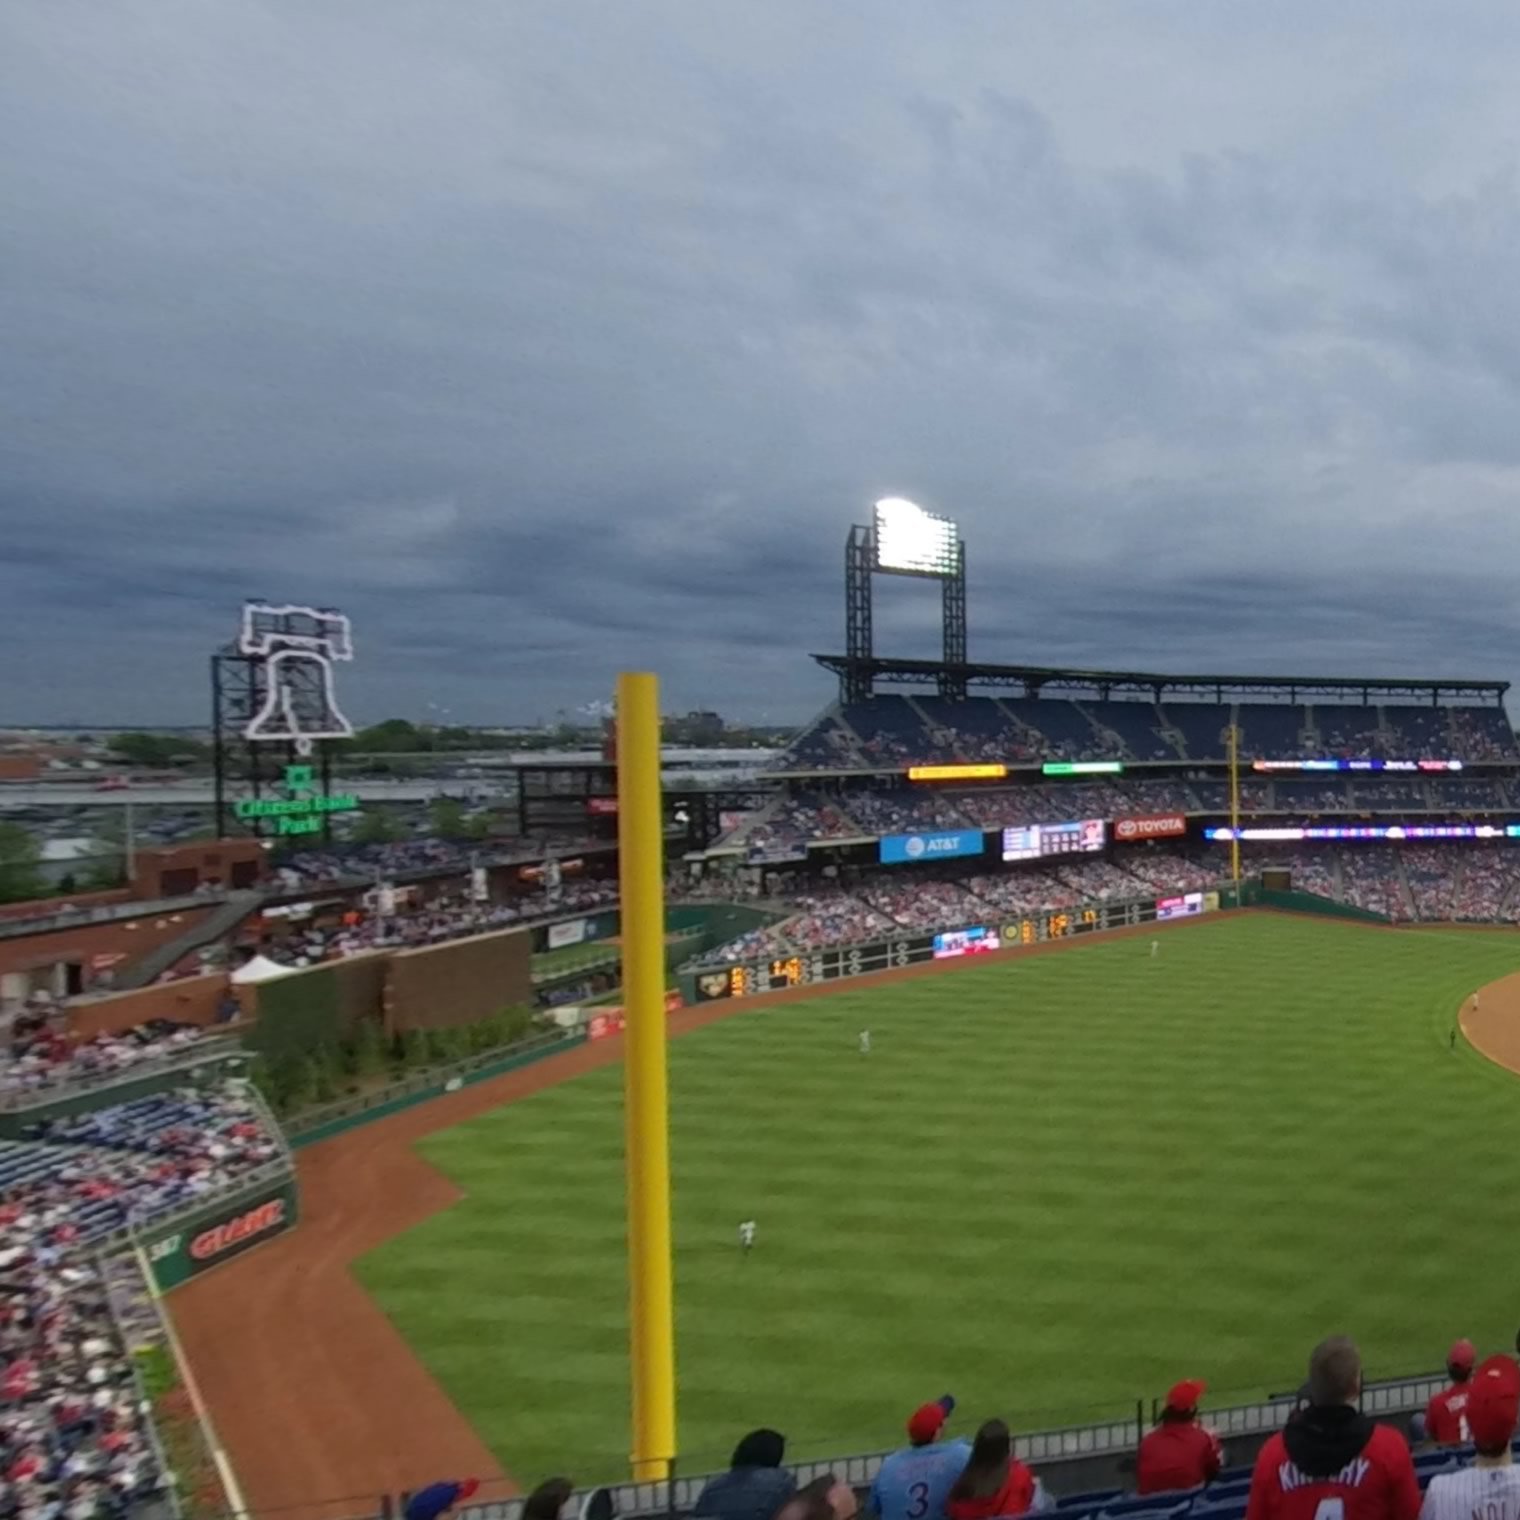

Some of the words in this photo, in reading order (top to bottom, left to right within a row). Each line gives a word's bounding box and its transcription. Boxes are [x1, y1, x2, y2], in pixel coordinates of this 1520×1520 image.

[236, 799, 311, 817] Citizens
[279, 816, 321, 834] Park
[1138, 818, 1183, 833] TOYOTA
[927, 836, 960, 851] AT&T
[190, 1199, 285, 1258] GIANT
[906, 1481, 929, 1519] 3
